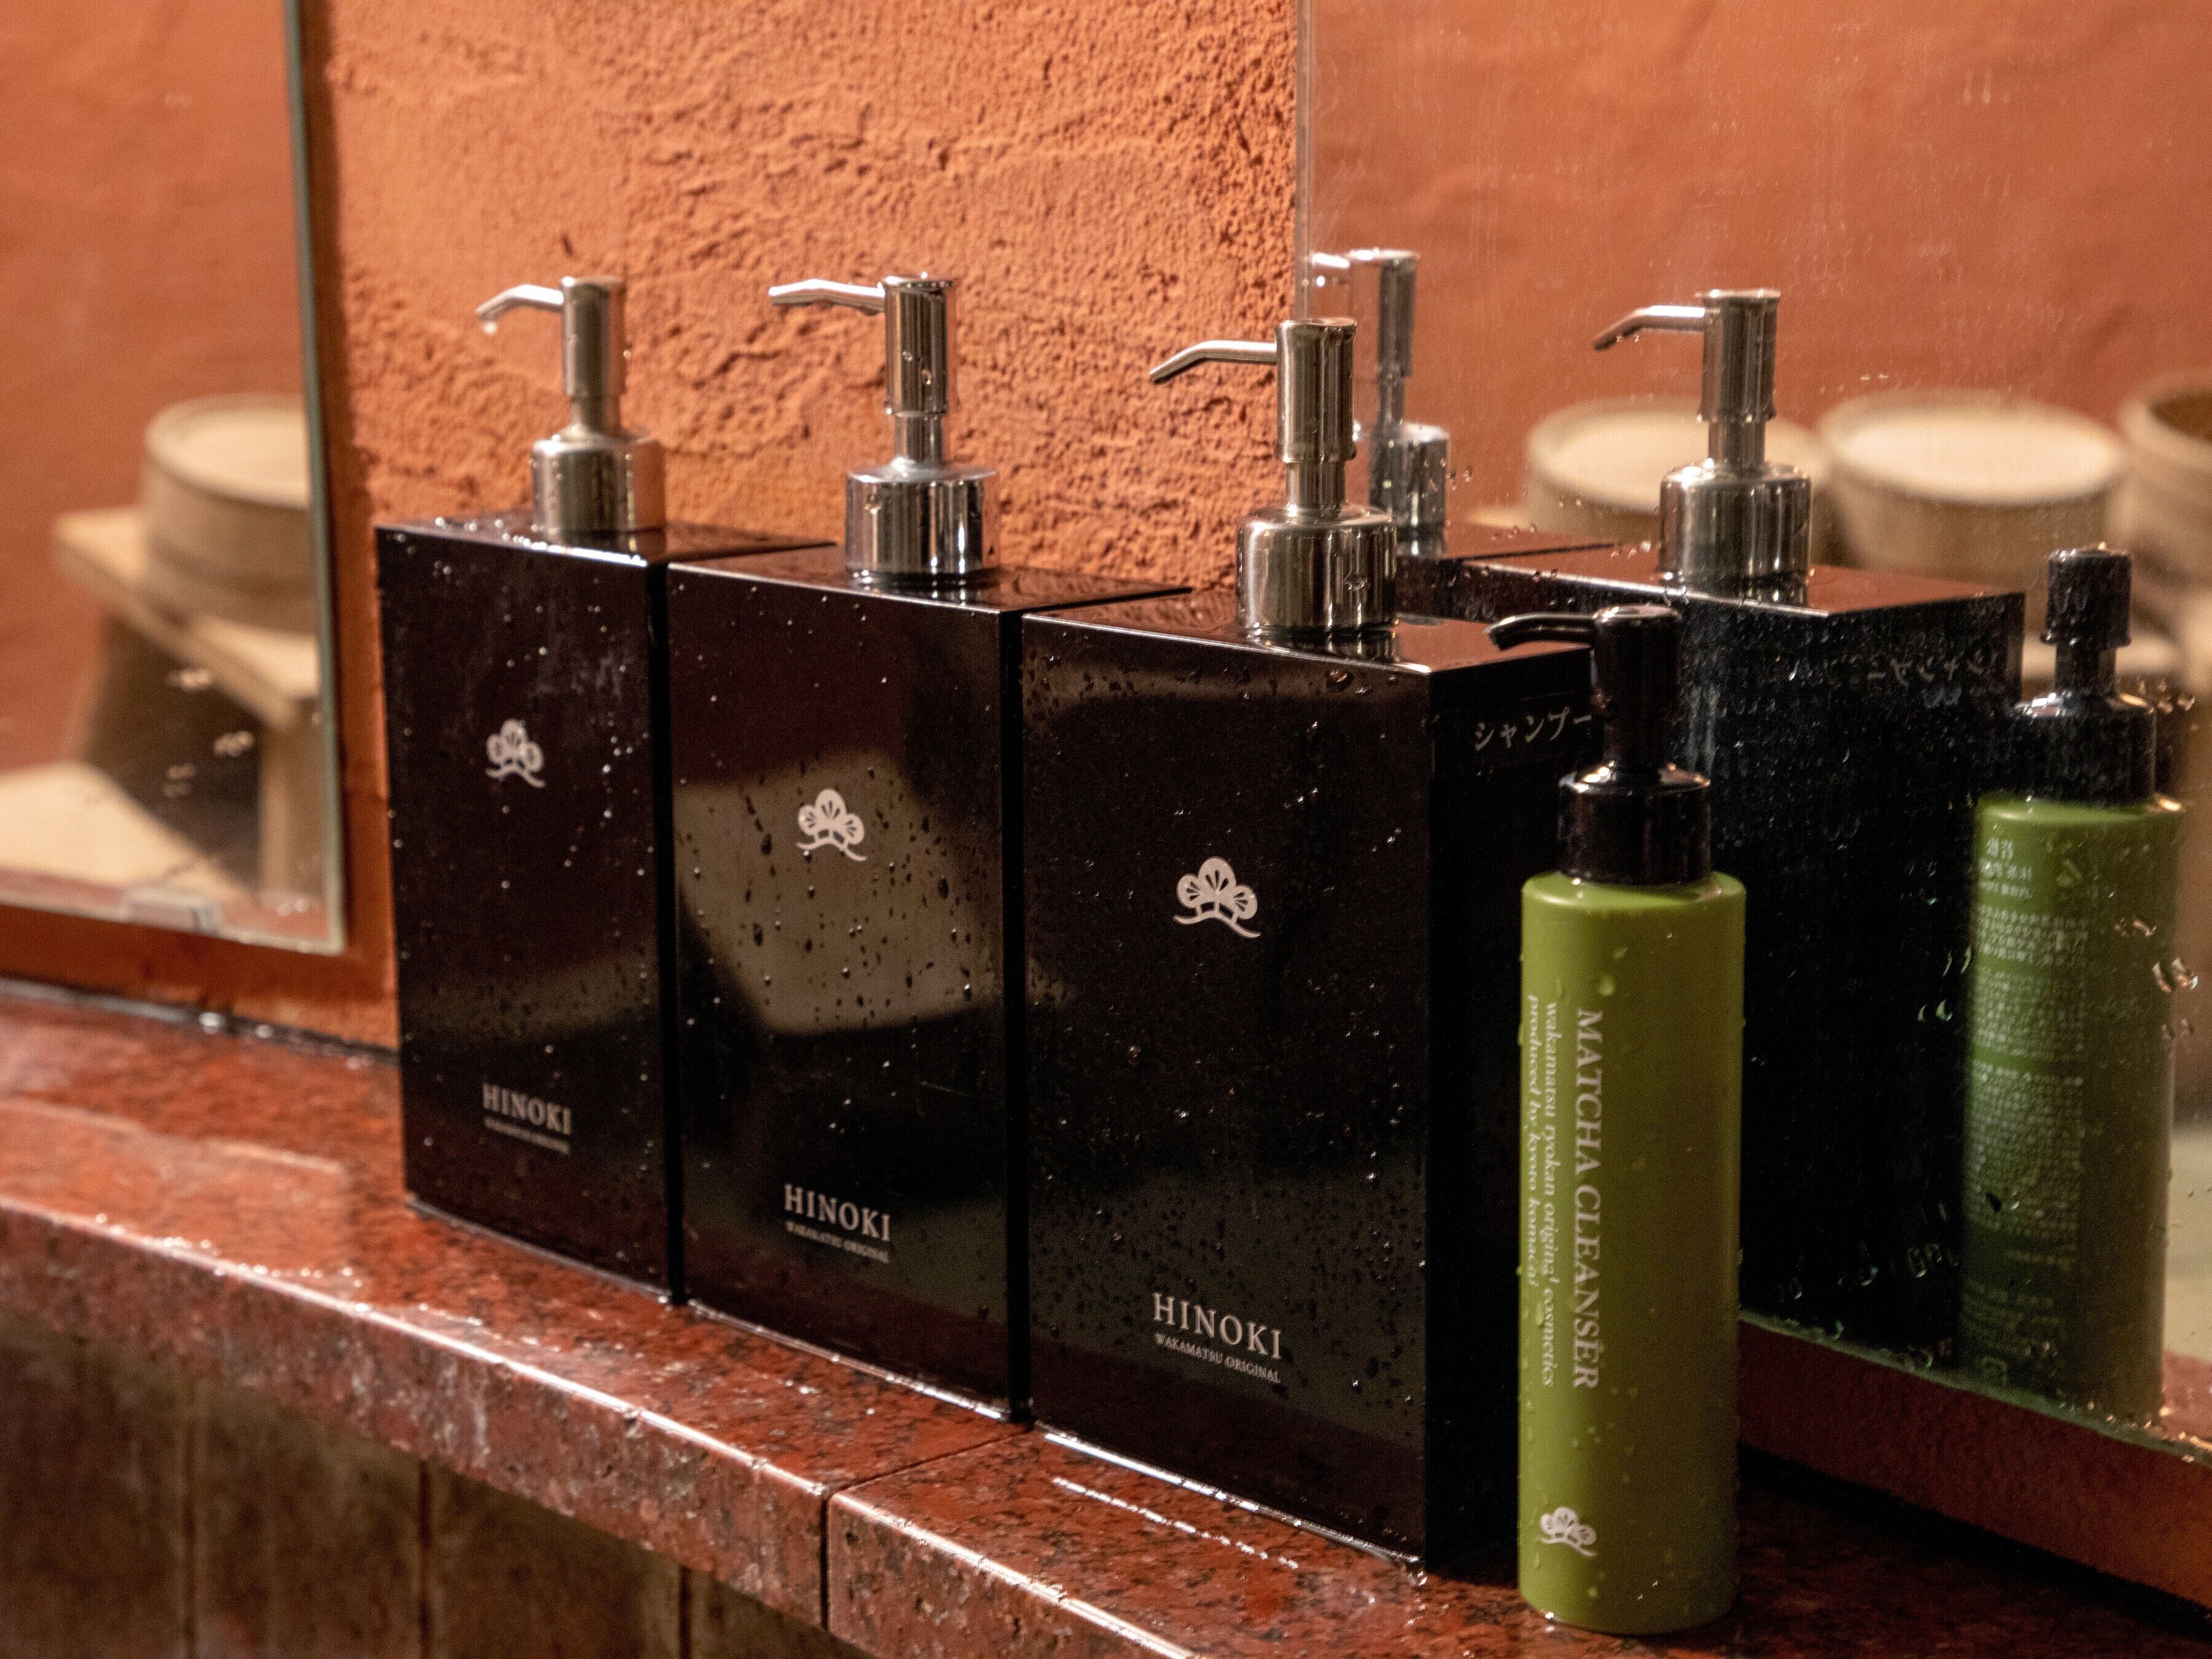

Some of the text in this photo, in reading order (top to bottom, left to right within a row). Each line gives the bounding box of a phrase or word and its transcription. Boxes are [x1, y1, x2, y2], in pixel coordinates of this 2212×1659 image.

[1475, 707, 1593, 751] シャンプー
[1544, 1002, 1563, 1117] wakamatsu
[482, 1083, 571, 1135] HINOKI
[784, 1182, 891, 1241] HINOKI
[1573, 1008, 1602, 1389] MATCHA CLEANSER
[1153, 1292, 1282, 1360] HINOKI
[1154, 1332, 1281, 1383] WAKAMATSU ORIGINAL
[1542, 1288, 1558, 1387] cosmetics
